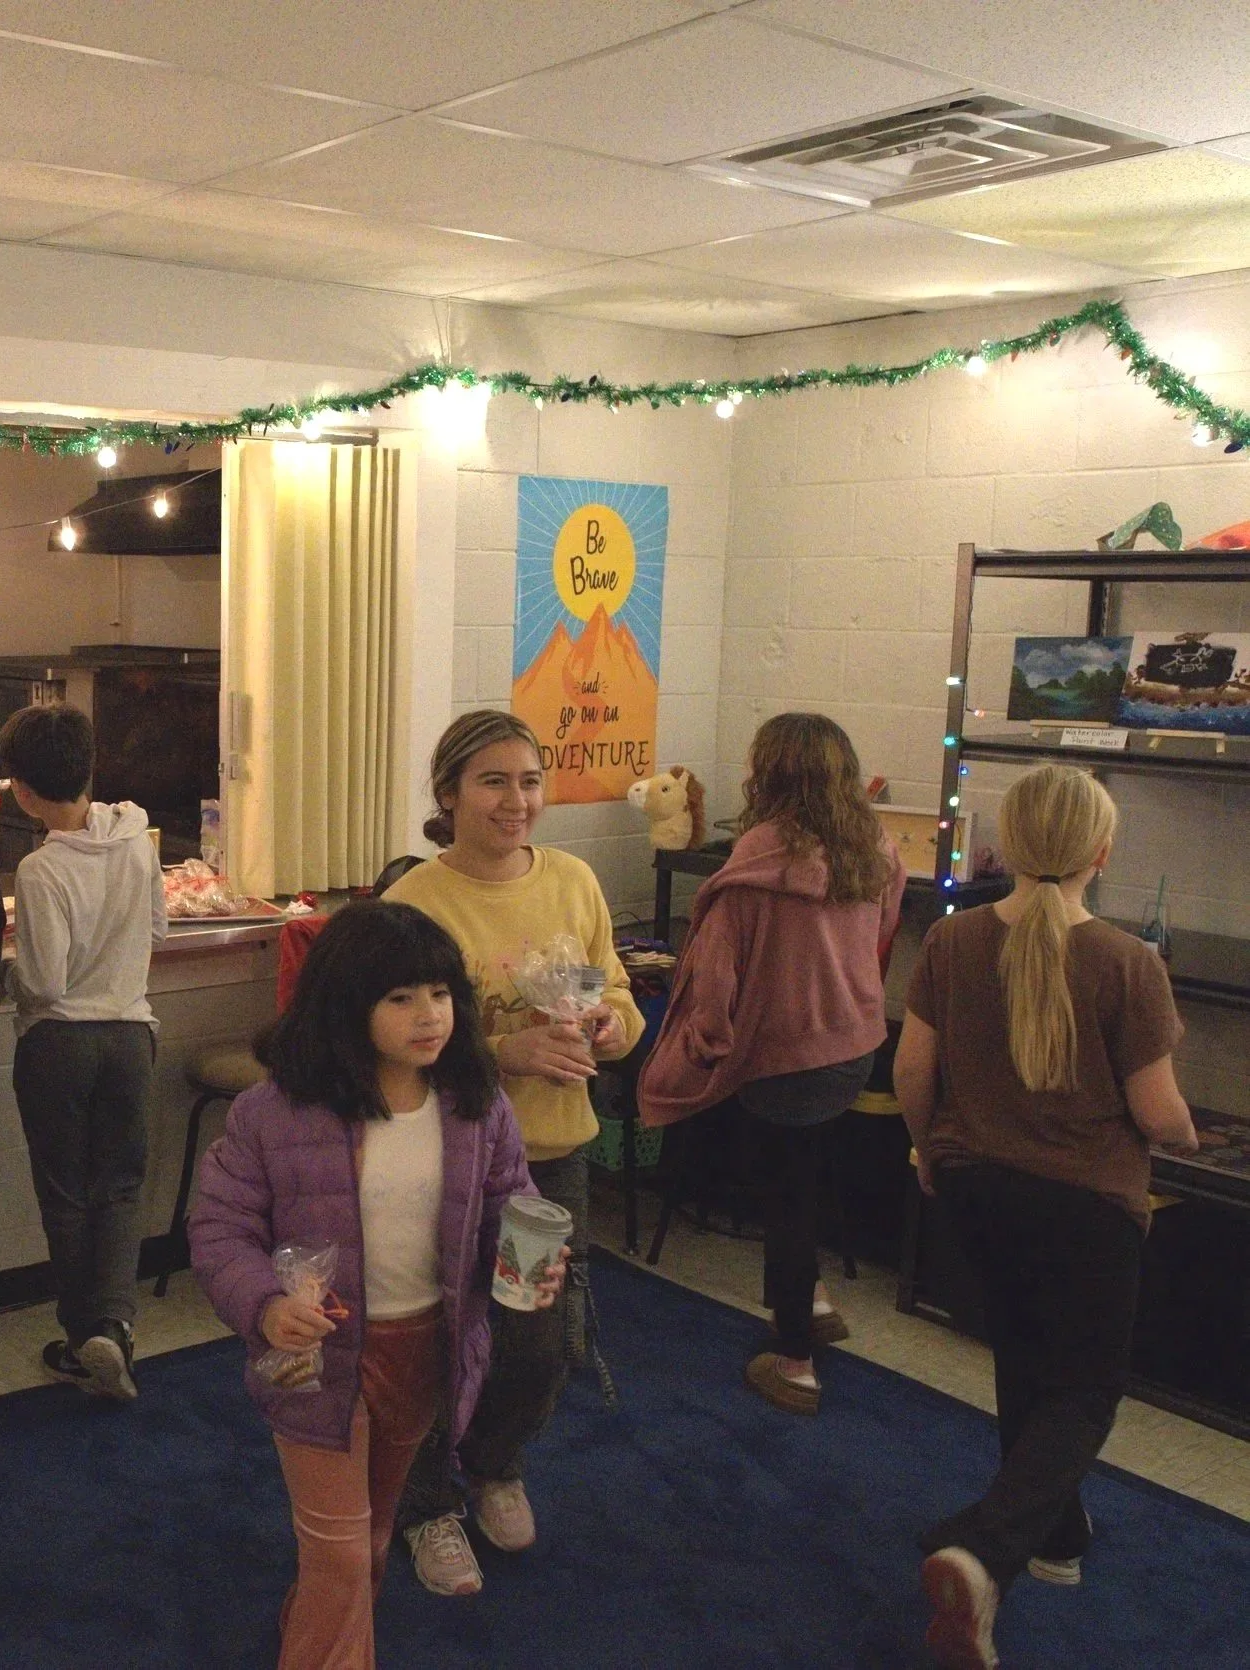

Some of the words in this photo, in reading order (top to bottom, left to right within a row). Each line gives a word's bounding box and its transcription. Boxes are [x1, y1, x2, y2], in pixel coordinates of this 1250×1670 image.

[586, 519, 606, 554] Be
[570, 555, 619, 595] Brave
[581, 671, 600, 694] and
[556, 706, 576, 739] go
[581, 705, 598, 723] on
[603, 705, 619, 722] an
[539, 741, 650, 776] DVENTURE
